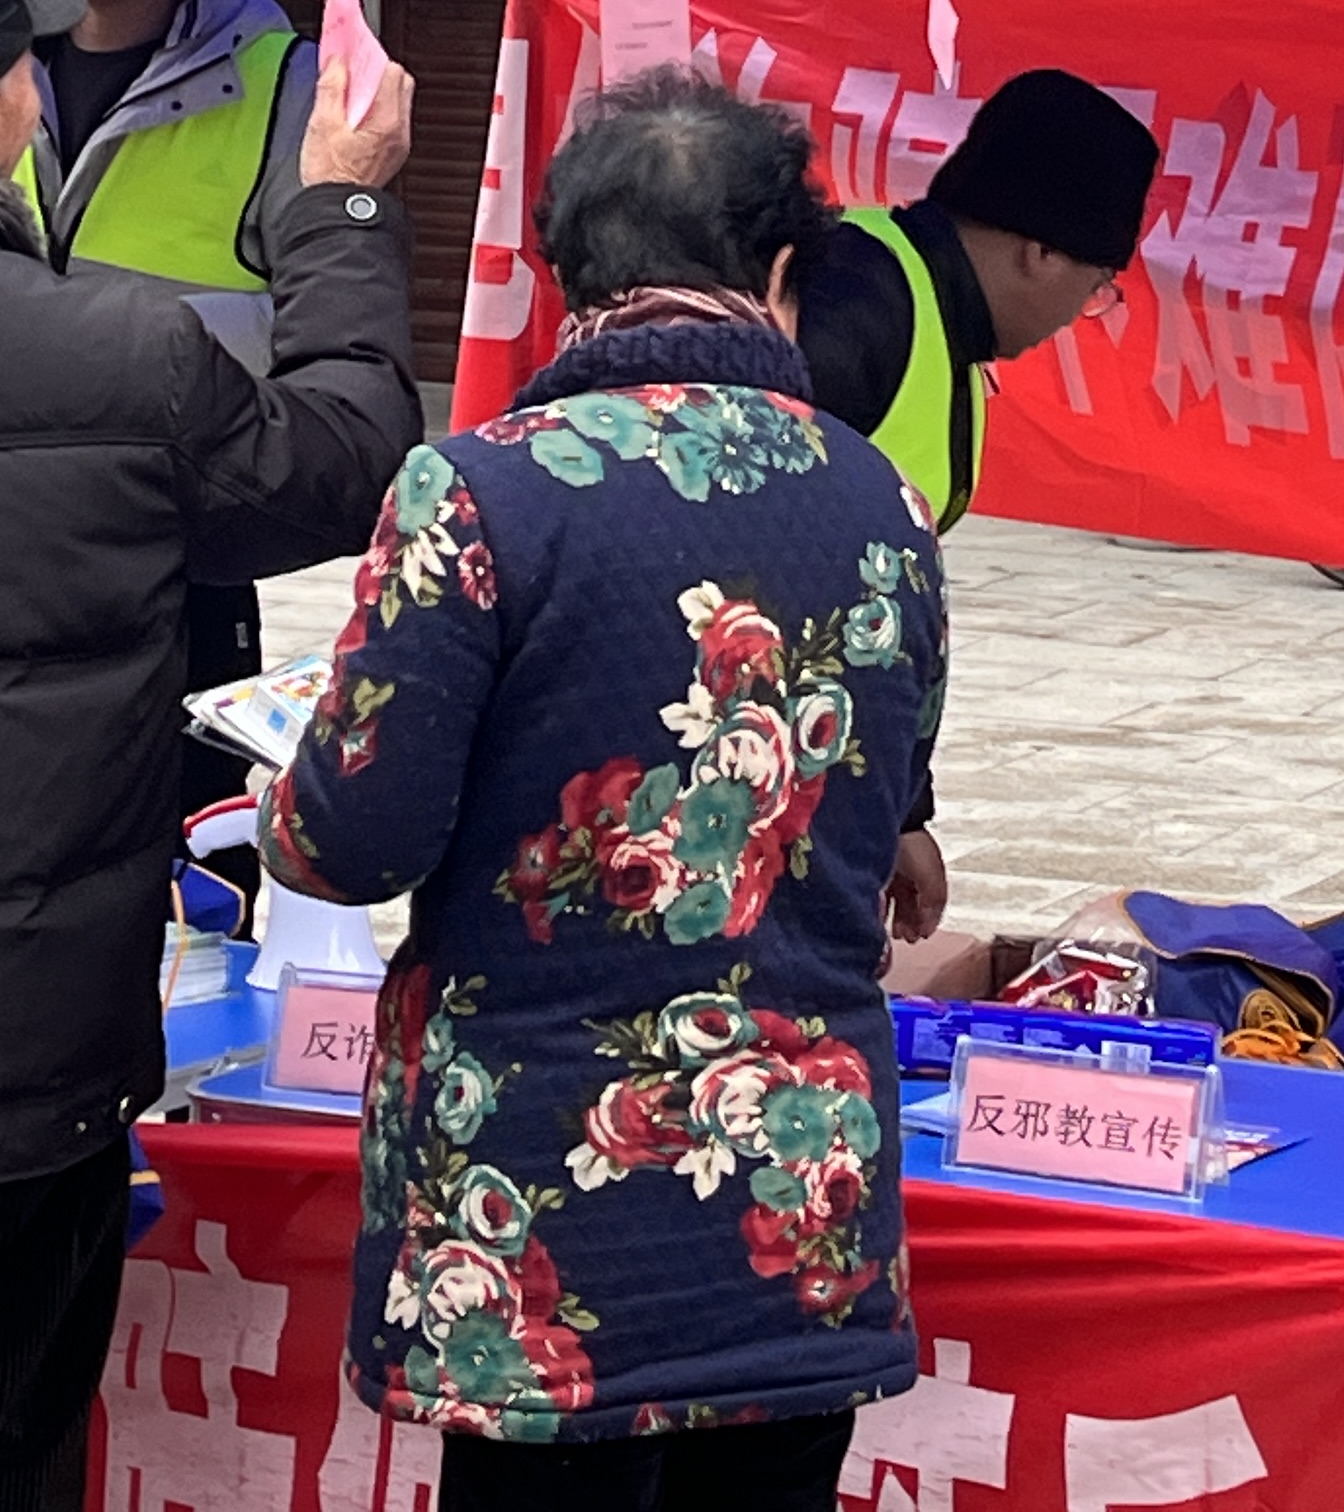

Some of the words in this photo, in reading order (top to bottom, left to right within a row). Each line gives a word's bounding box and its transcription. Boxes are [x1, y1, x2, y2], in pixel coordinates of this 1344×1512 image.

[967, 1094, 1183, 1161] 反邪教宣传
